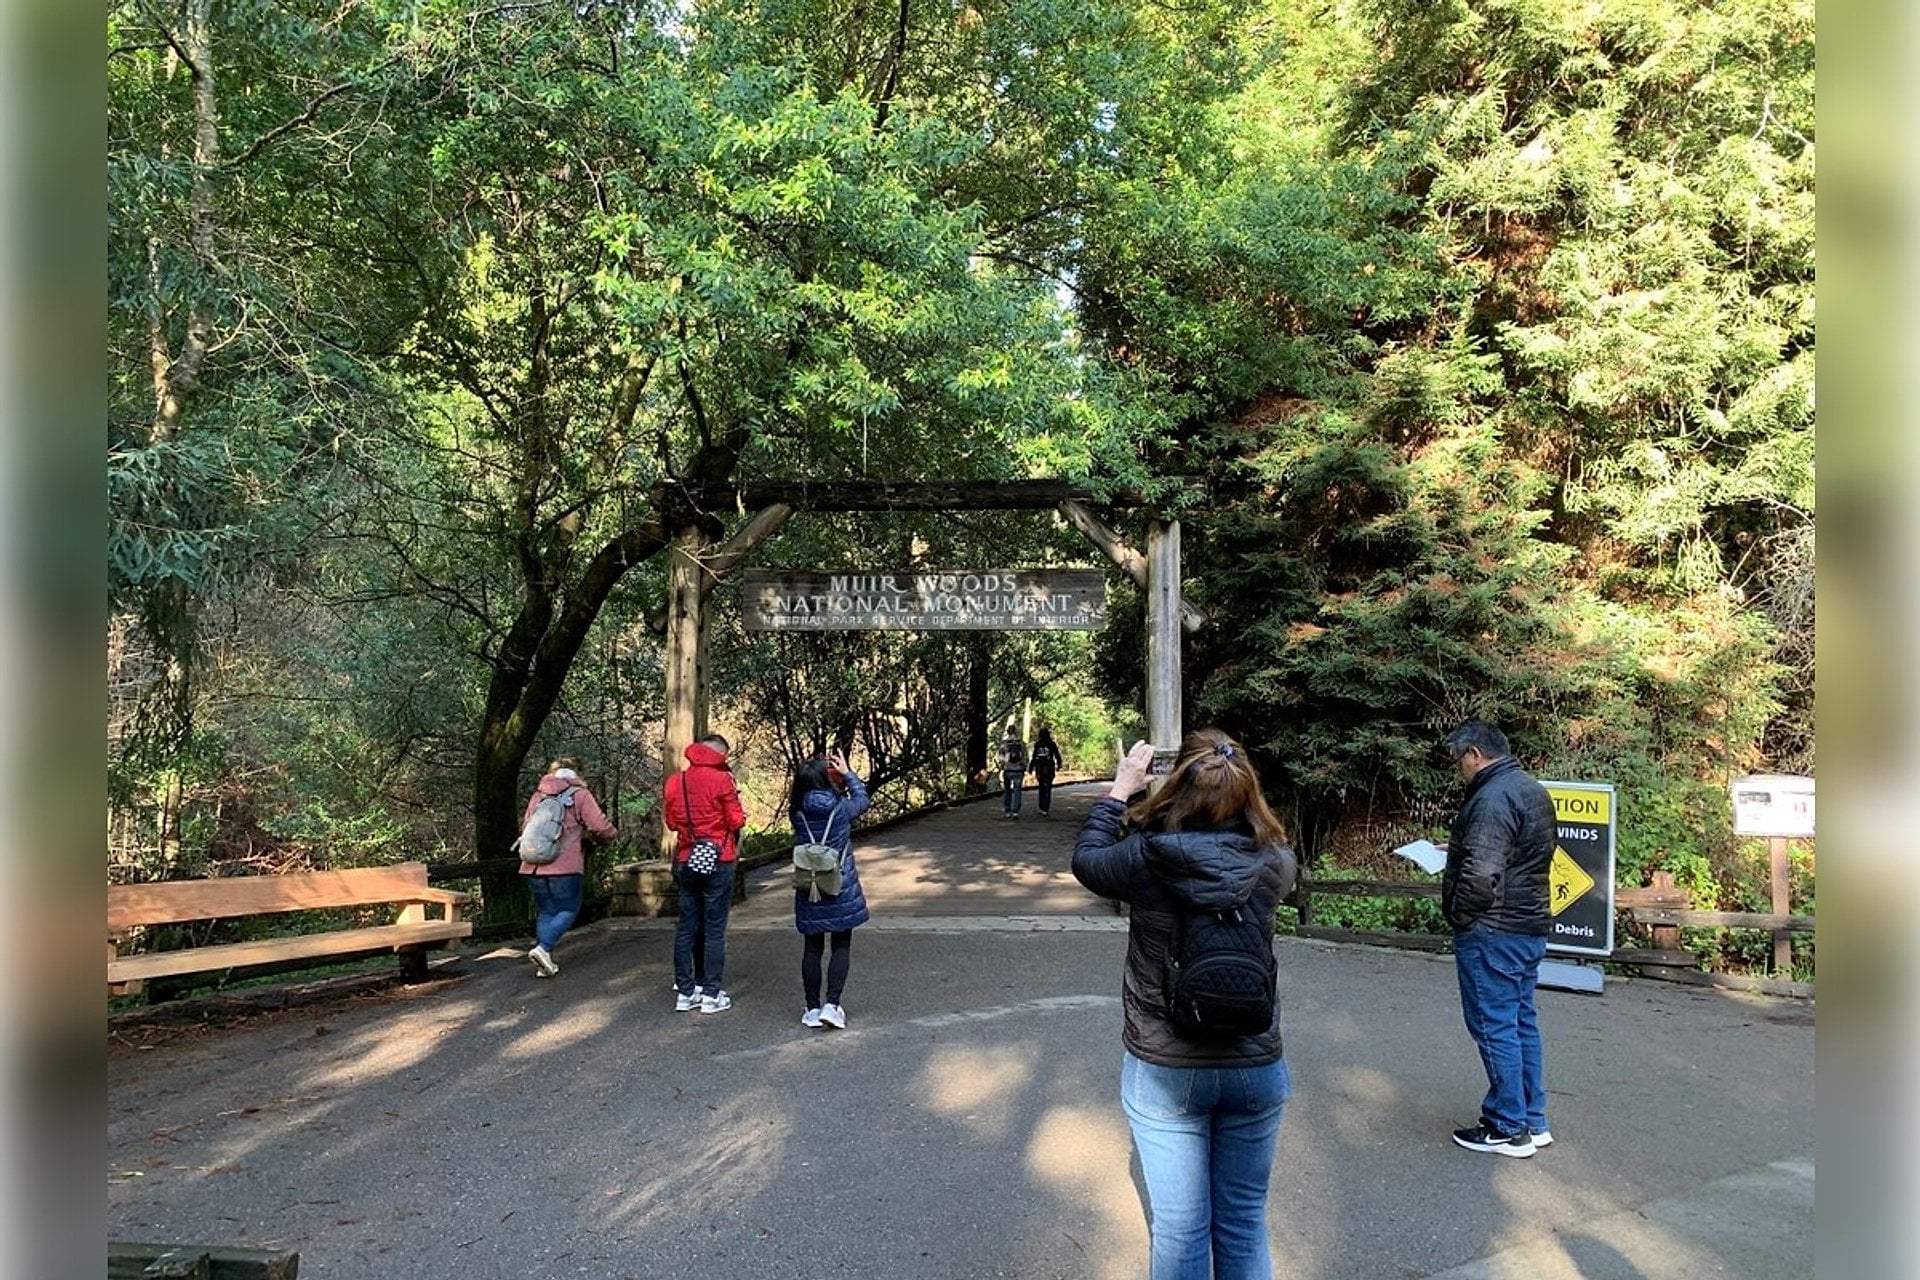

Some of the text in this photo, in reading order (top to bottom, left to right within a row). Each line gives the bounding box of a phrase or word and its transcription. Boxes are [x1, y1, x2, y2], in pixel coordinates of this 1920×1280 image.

[830, 574, 1017, 593] MUIR WOODS
[777, 594, 1072, 612] NATIONAL MONUMENT
[832, 615, 864, 625] PARK
[872, 615, 924, 625] SERVICE
[1554, 798, 1598, 814] TION
[1555, 923, 1594, 937] Debris
